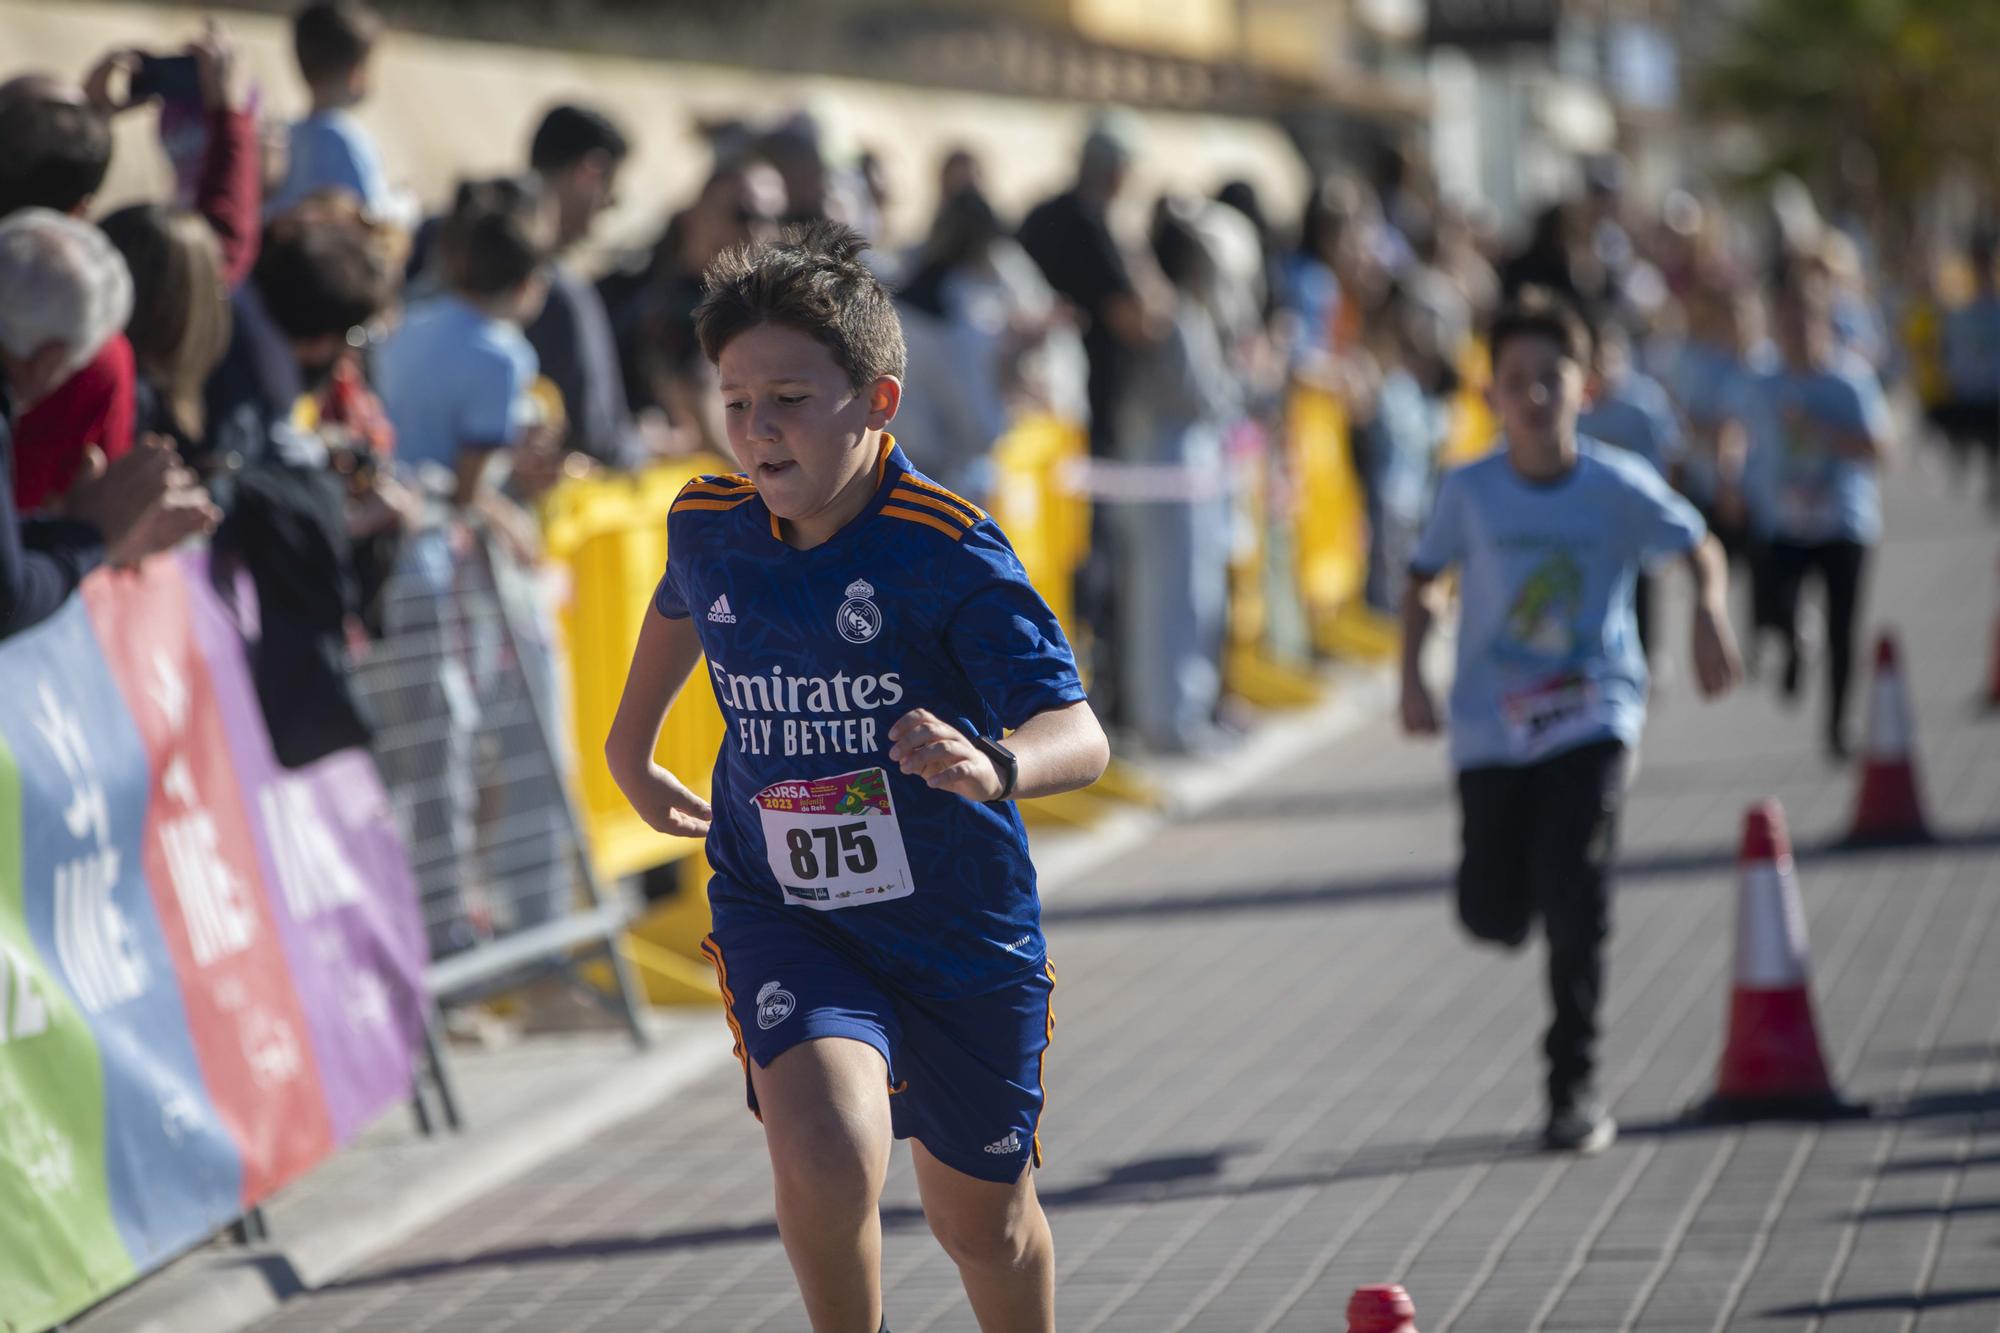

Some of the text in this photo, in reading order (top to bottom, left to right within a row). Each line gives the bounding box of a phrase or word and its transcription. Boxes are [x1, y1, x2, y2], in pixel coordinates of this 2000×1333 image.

[707, 612, 737, 624] adidas
[711, 660, 903, 712] Emirates
[739, 716, 879, 757] FLY BETTER
[760, 786, 810, 798] CURSA
[765, 799, 792, 809] 2023
[786, 821, 877, 880] 875
[983, 1143, 1021, 1155] adidas
